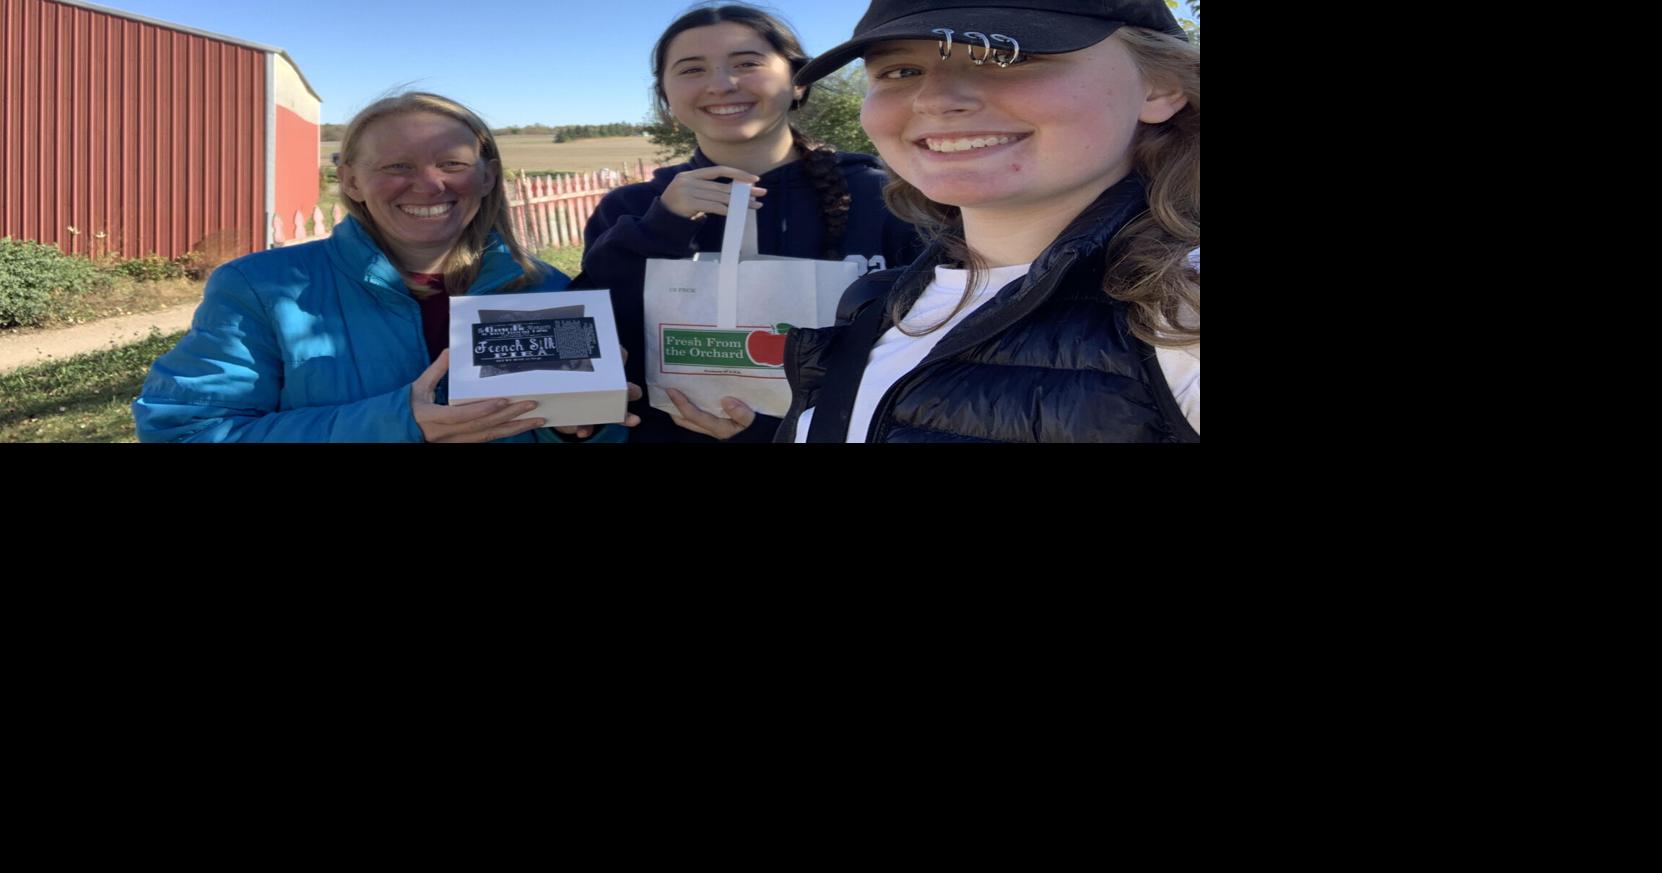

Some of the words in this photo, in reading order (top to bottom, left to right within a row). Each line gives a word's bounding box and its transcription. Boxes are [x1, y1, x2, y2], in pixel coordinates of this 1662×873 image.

[474, 339, 524, 354] French
[666, 336, 702, 347] Fresh
[706, 337, 741, 348] From
[666, 346, 687, 356] the
[689, 347, 744, 359] Orchard
